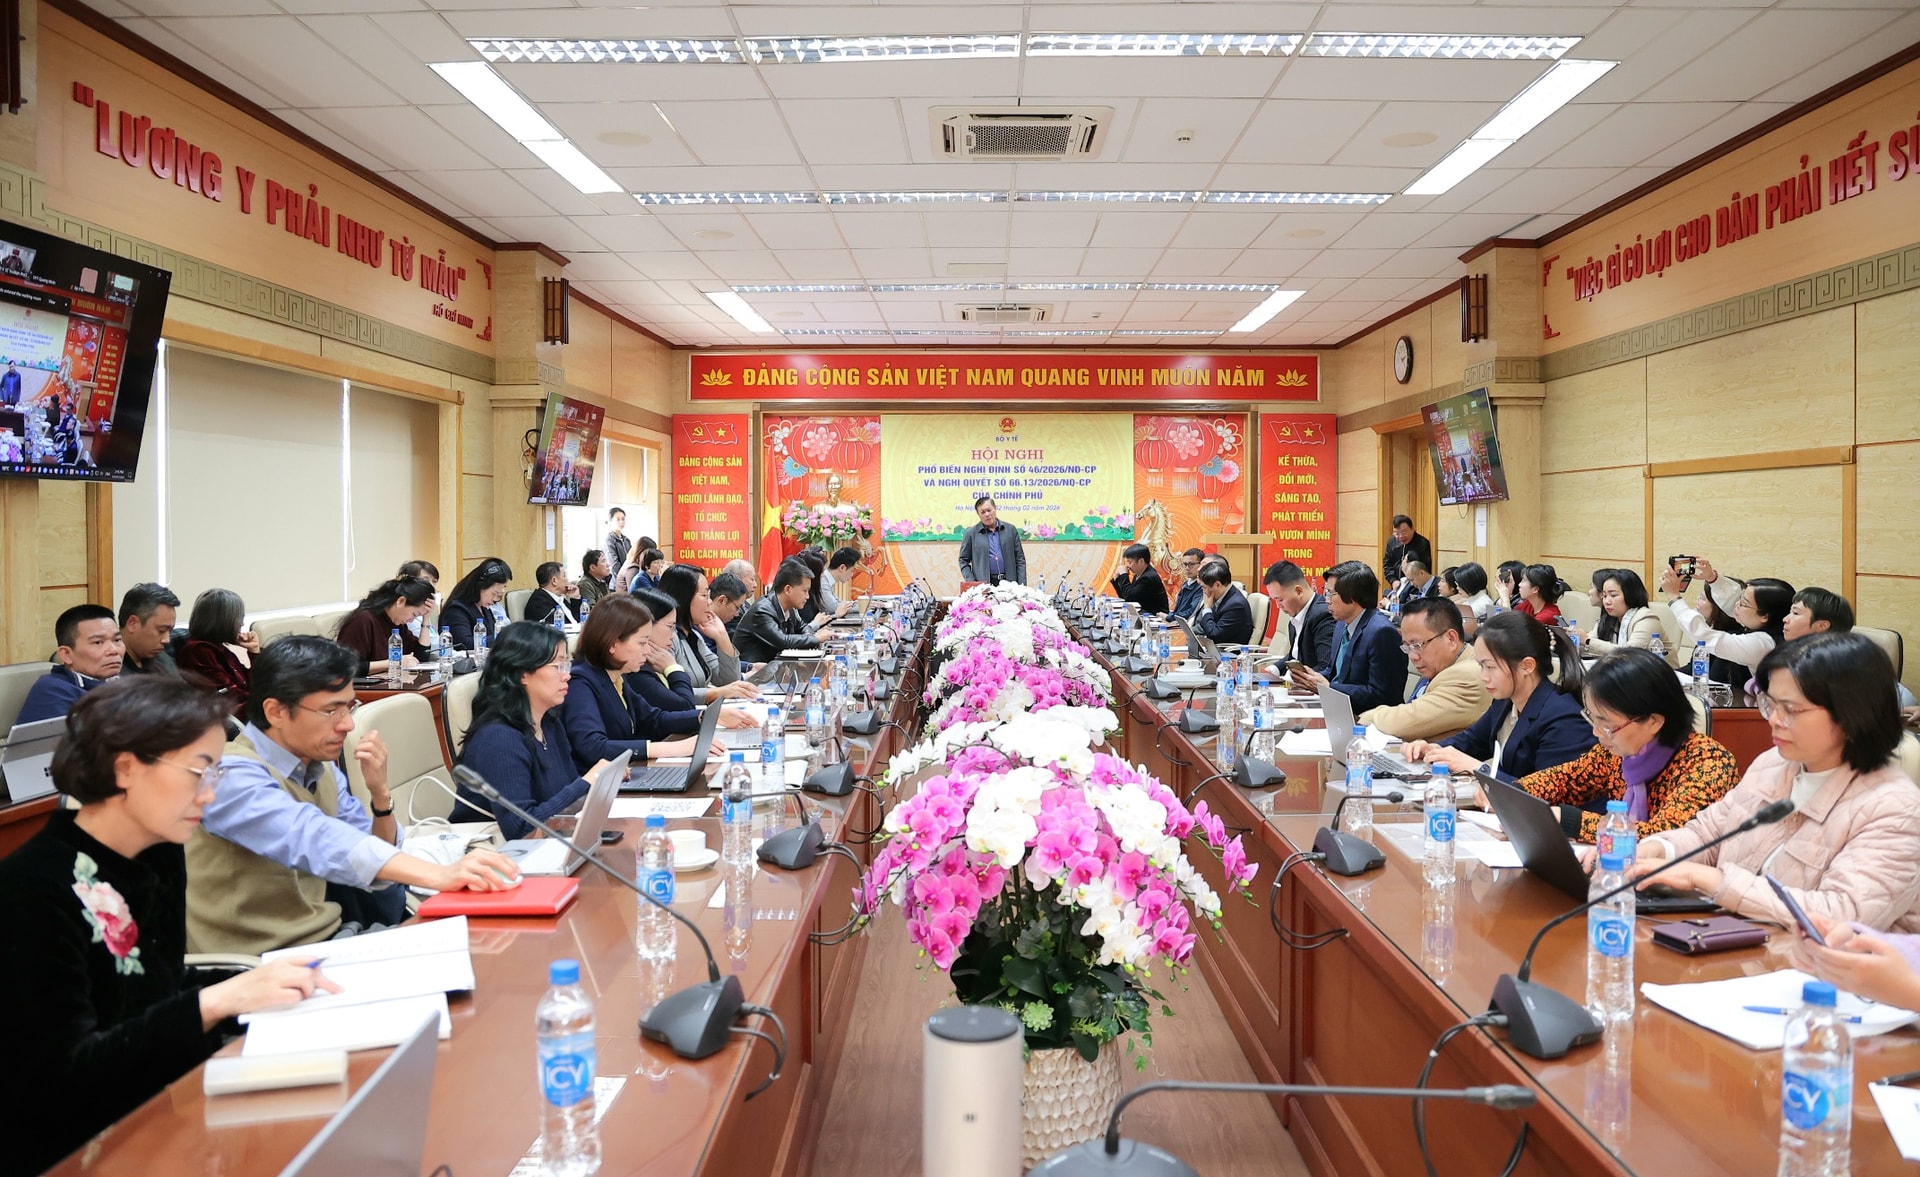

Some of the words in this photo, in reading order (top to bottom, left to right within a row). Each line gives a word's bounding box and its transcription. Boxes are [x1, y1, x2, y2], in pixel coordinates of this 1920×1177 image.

[73, 81, 222, 202] "LƯƠNG
[236, 166, 255, 214] Y
[266, 179, 330, 248] PHẢI
[338, 213, 385, 268] NHƯ
[389, 236, 416, 281] TỪ
[1606, 244, 1621, 289] GÌ
[1623, 234, 1643, 282] CÓ
[1646, 230, 1671, 278] LỢI
[1675, 214, 1710, 262] CHO
[1716, 192, 1759, 248] DÂN
[1765, 154, 1821, 229] PHẢI
[1829, 130, 1880, 205] HẾT
[743, 362, 798, 386] ĐẢNG
[805, 364, 860, 390] CỘNG
[867, 362, 909, 386] SẢN
[916, 364, 959, 389] VIỆT
[966, 368, 1014, 386] NAM
[1021, 368, 1090, 387] QUANG
[1097, 368, 1144, 386] VINH
[1151, 365, 1210, 386] MUÔN
[1217, 365, 1264, 386] NĂM
[971, 446, 999, 462] HỘI
[1005, 450, 1044, 462] NGHỊ
[1278, 454, 1290, 466] KẾ
[1293, 455, 1318, 467] THỪA,
[679, 454, 700, 467] ĐẢNG
[702, 456, 724, 468] CỘNG
[726, 454, 742, 467] SẢN
[964, 466, 986, 475] NGHỊ
[989, 466, 1010, 475] ĐỊNH
[1014, 464, 1026, 473] SỐ
[691, 474, 707, 487] VIỆT
[709, 476, 730, 486] NAM,
[924, 477, 935, 486] VÀ
[938, 479, 960, 488] NGHỊ
[963, 477, 991, 487] QUYẾT
[994, 476, 1007, 486] SỐ
[1279, 472, 1294, 485] ĐỔI
[1297, 473, 1317, 486] MỚI,
[678, 493, 702, 504] NGƯỜI
[994, 490, 1022, 499] CHÍNH
[1025, 489, 1043, 499] PHỦ
[1274, 492, 1299, 503] SÁNG
[1302, 493, 1321, 505] TẠO,
[695, 510, 705, 522] TỔ
[706, 511, 727, 522] CHỨC
[1272, 510, 1295, 521] PHÁT
[1298, 508, 1324, 521] TRIỂN
[683, 531, 698, 542] MỌI
[700, 528, 725, 541] THẮNG
[727, 531, 740, 542] LỢI
[1279, 529, 1304, 540] VƯƠN
[1306, 528, 1330, 540] MÌNH
[679, 547, 695, 559] CỦA
[697, 548, 718, 559] CÁCH
[720, 549, 744, 561] MẠNG
[1283, 549, 1312, 559] TRONG
[762, 746, 775, 756] CY
[1432, 818, 1453, 832] ICY
[1599, 927, 1629, 945] ICY
[545, 1060, 585, 1089] ICY
[1784, 1082, 1821, 1112] CY
